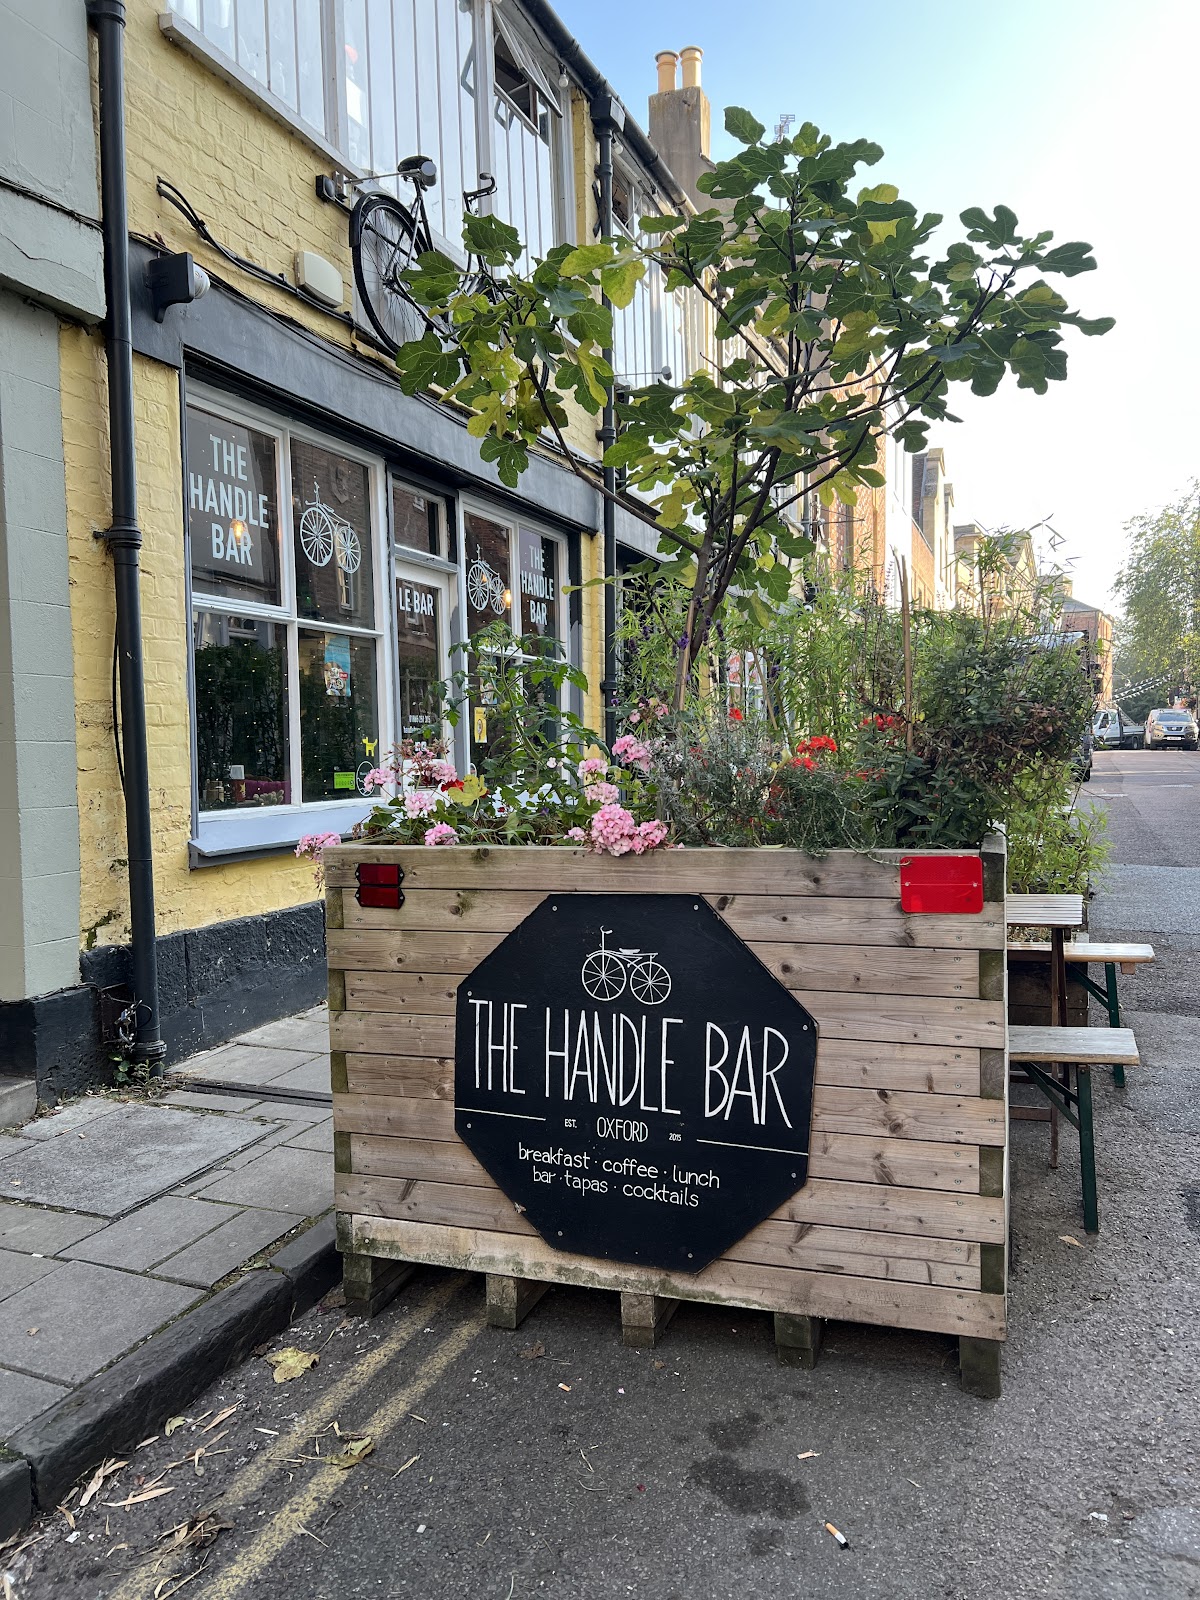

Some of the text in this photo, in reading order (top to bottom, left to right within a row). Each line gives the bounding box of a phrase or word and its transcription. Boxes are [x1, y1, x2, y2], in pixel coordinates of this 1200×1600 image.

[209, 433, 248, 481] THE
[189, 472, 269, 529] HANDLE
[211, 522, 253, 567] BAR
[528, 545, 546, 572] THE
[413, 590, 434, 617] BAR
[521, 570, 554, 601] HANDLE
[529, 600, 548, 626] BAR
[468, 998, 793, 1129] THE HANDLE BAR
[596, 1116, 649, 1143] OXFORD
[668, 1132, 682, 1142] 2015
[518, 1142, 720, 1189] breakfast coffee lunch
[532, 1165, 699, 1208] bar tapas cocktails
